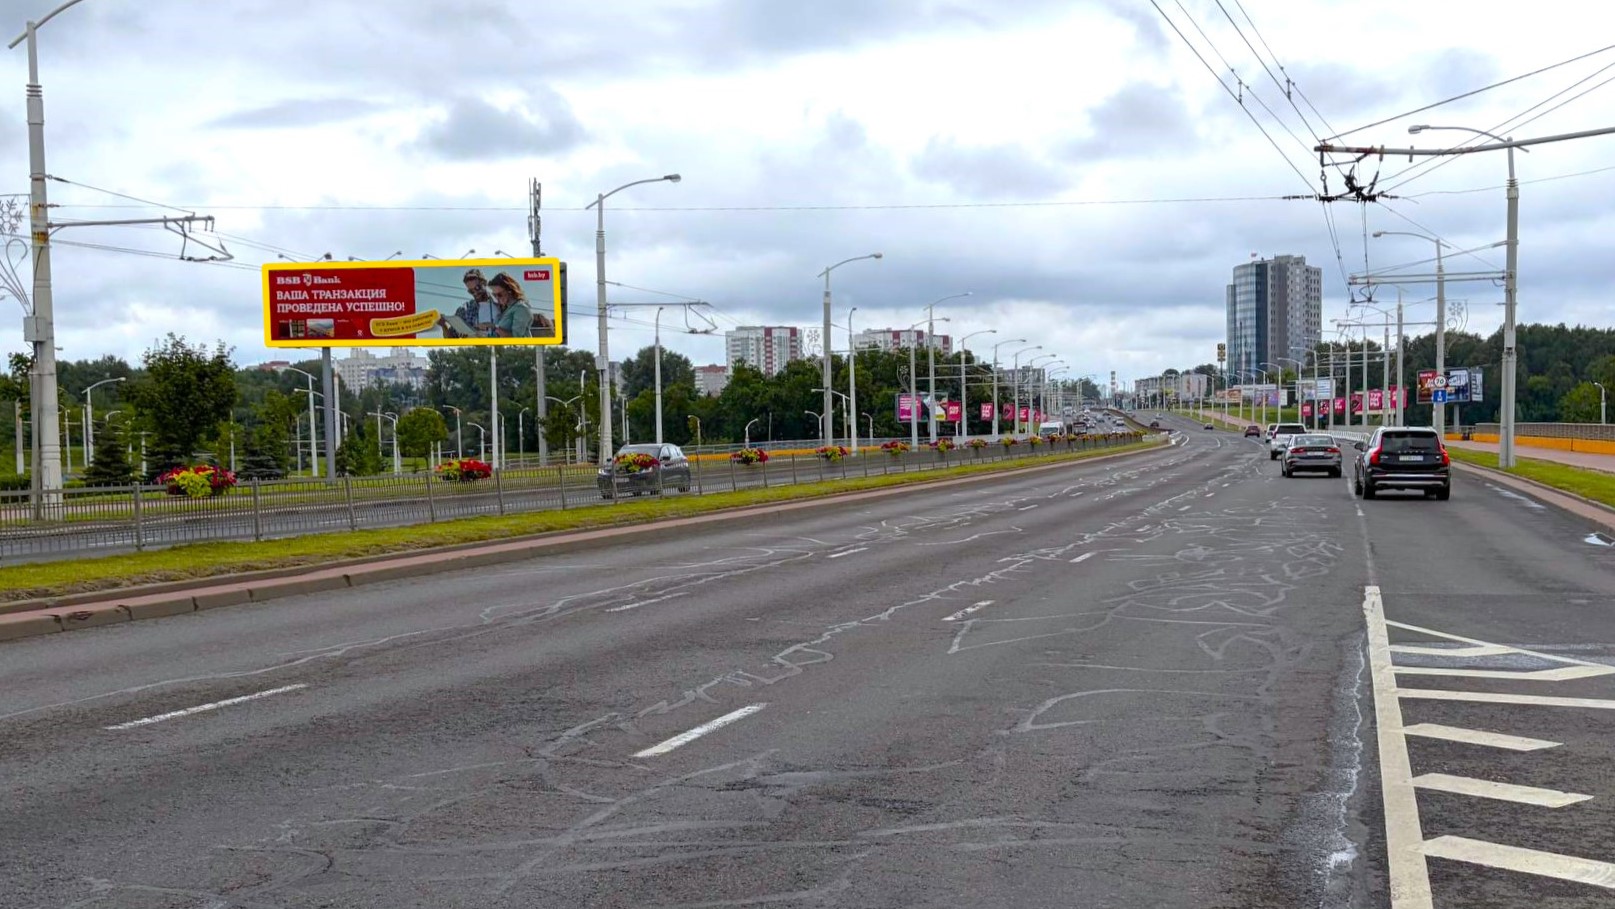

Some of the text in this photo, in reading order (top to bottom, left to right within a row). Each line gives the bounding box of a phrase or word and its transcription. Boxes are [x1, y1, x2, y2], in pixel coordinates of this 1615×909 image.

[276, 275, 341, 285] BSB Bank
[276, 289, 387, 300] ВАША ТРАНЗАКЦИЯ
[276, 301, 405, 314] ПРОВЕДЕНА УСПЕШНО!
